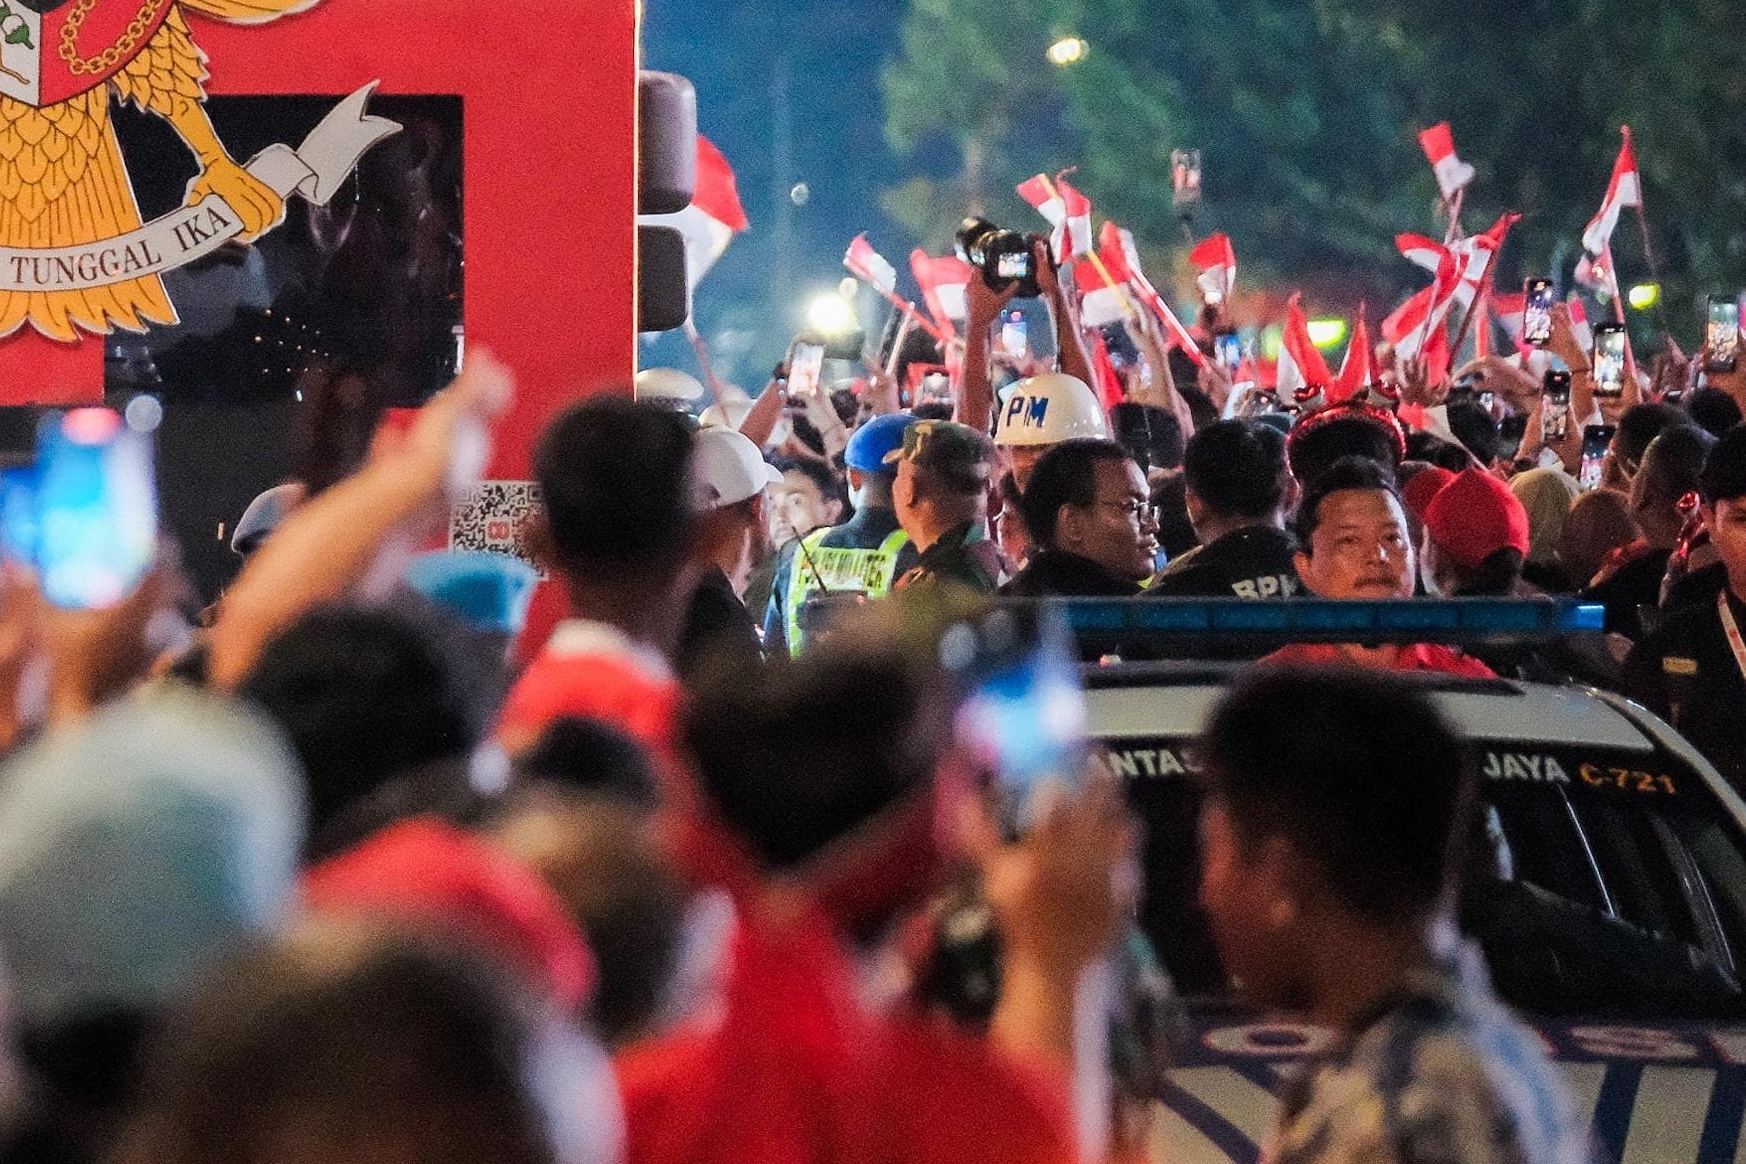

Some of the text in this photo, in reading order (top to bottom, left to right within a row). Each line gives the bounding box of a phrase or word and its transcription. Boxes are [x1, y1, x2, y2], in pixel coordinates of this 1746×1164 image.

[10, 239, 162, 285] TUNGGAL
[172, 206, 231, 253] IKA
[1006, 395, 1050, 428] PM
[1482, 751, 1571, 784] JAYA
